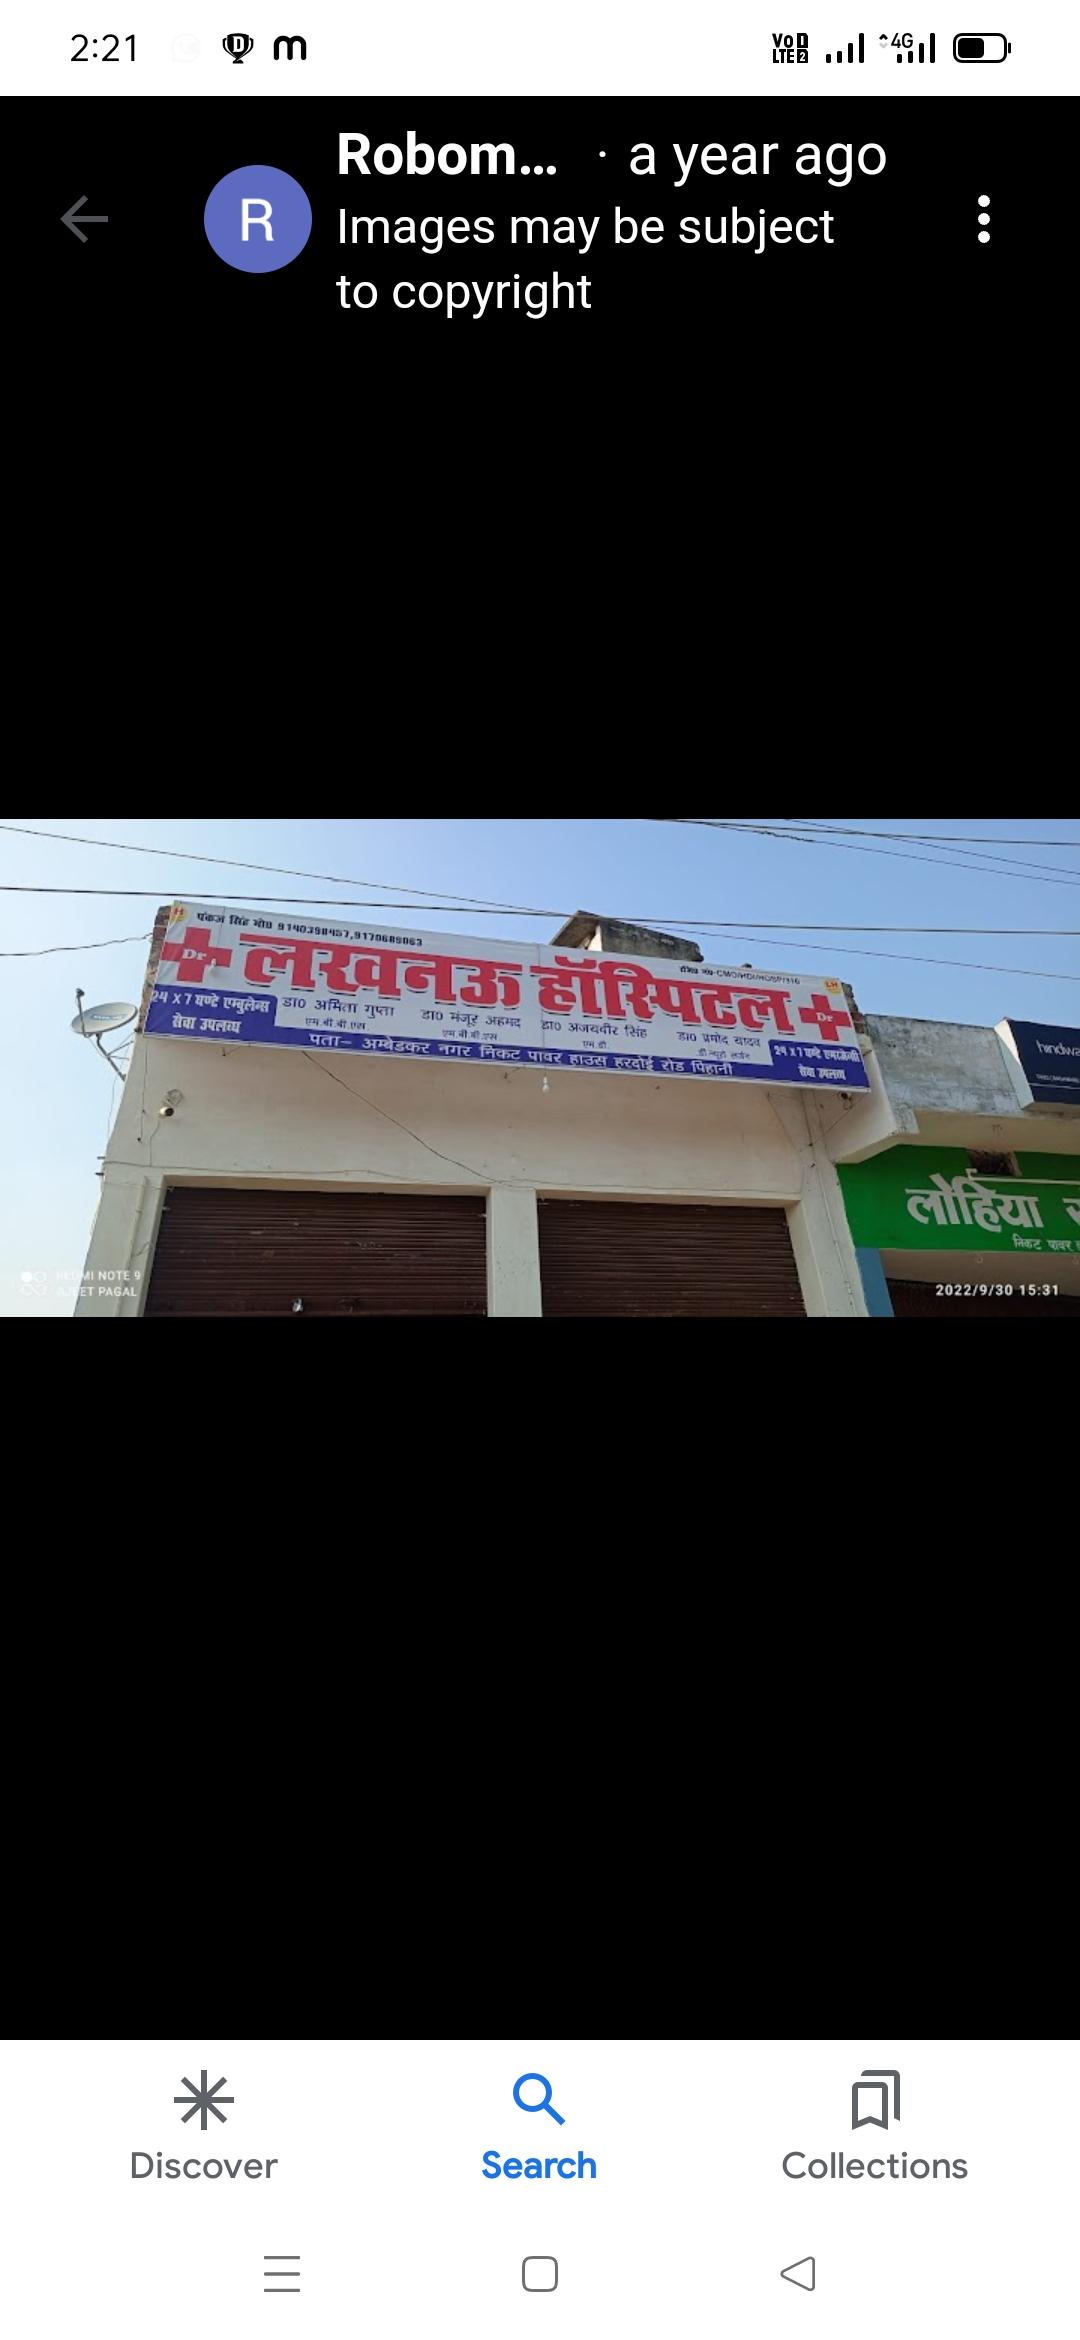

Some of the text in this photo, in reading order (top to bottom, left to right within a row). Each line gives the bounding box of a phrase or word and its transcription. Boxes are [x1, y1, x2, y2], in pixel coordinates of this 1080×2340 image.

[71, 34, 136, 62] 2:21
[890, 32, 914, 48] 4G
[629, 142, 656, 176] a
[672, 142, 779, 186] year
[795, 142, 887, 186] ago
[242, 200, 275, 241] R
[338, 207, 835, 252] Images may be subject
[336, 272, 592, 320] to copyright
[182, 948, 207, 961] Dr
[239, 933, 795, 1035] लखनऊ हॉस्पिटल
[172, 1013, 195, 1029] सेवा
[363, 1005, 395, 1019] गुप्ता
[815, 1012, 834, 1023] Dr
[624, 1024, 648, 1039] सिंह
[439, 1043, 473, 1057] नगर
[480, 1044, 521, 1061] निकट
[528, 1050, 563, 1064] पावर
[569, 1053, 607, 1068] हाउस
[614, 1056, 653, 1072] हरदोई
[662, 1058, 684, 1072] रोड
[692, 1059, 733, 1076] पिहानी
[905, 1167, 1044, 1233] लोहिया
[131, 2151, 279, 2180] Discover
[481, 2150, 597, 2180] Search
[782, 2151, 968, 2180] Collections
